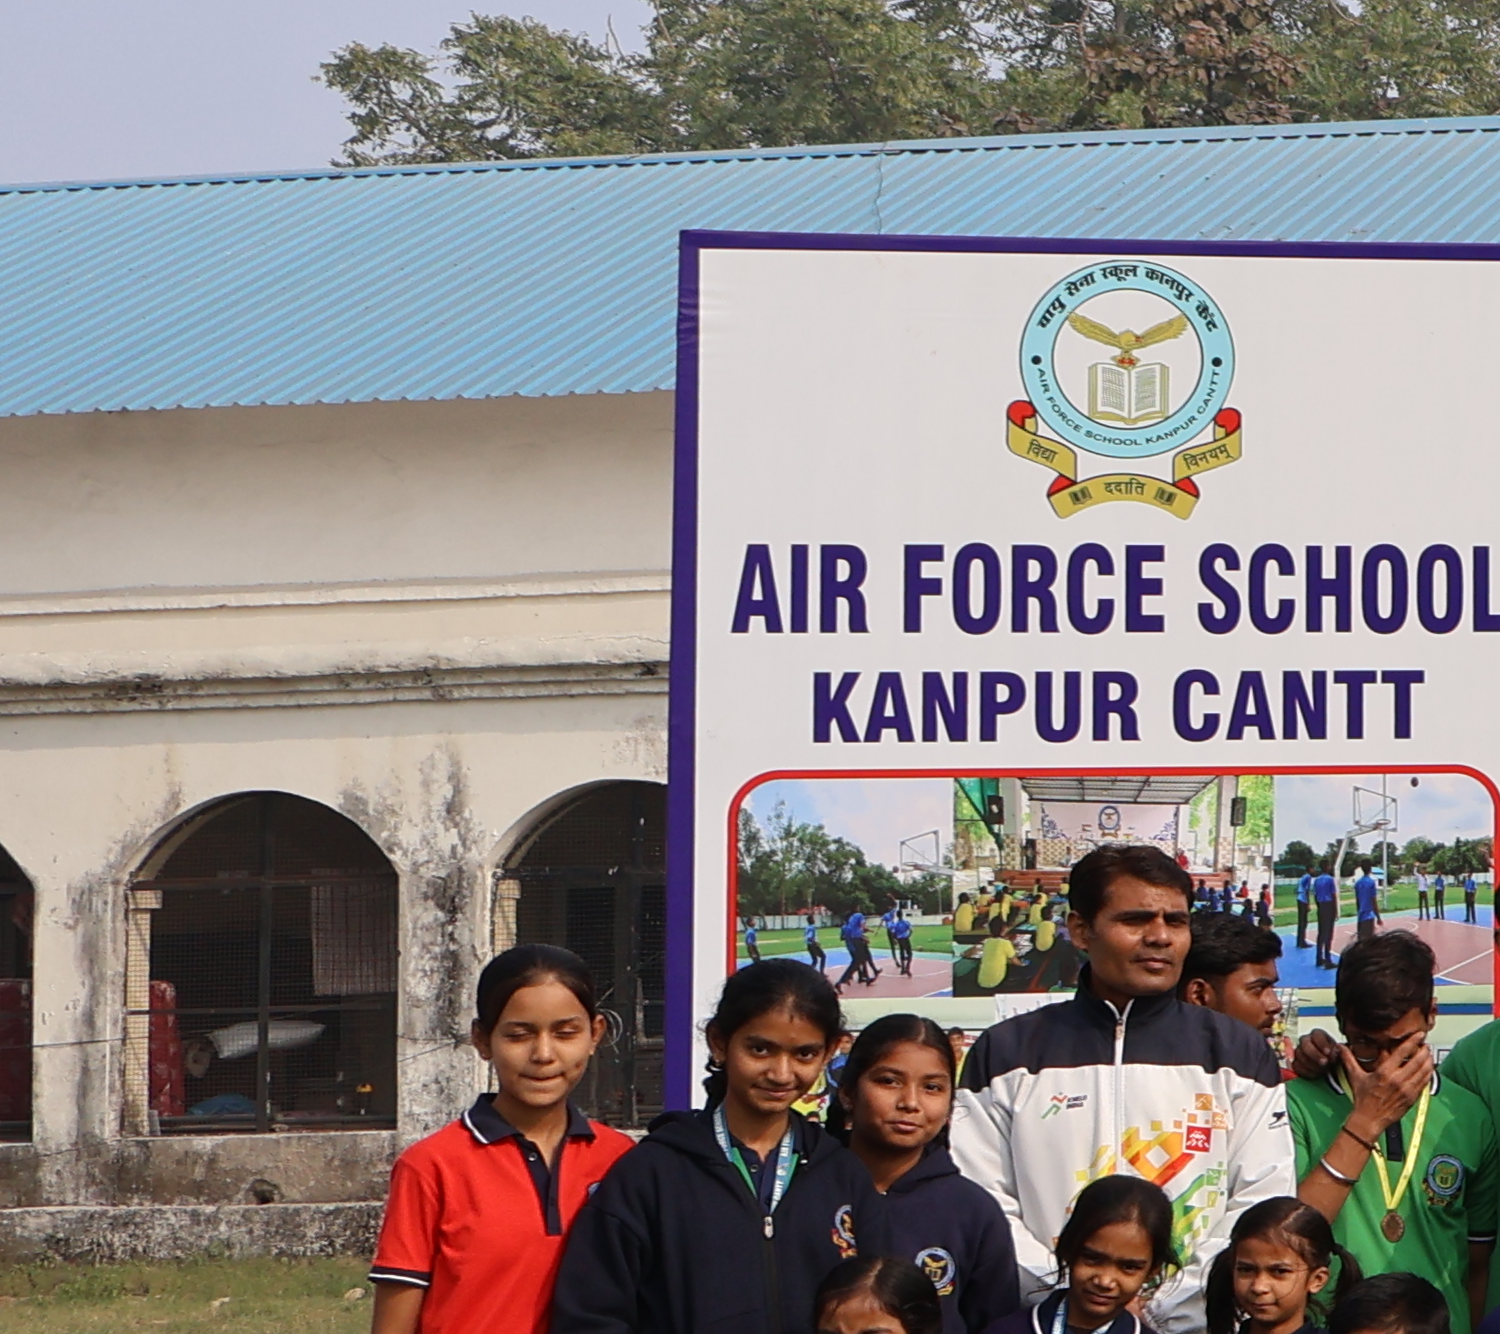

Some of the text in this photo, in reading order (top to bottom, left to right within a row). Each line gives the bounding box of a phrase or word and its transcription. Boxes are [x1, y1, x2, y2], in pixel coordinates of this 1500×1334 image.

[1100, 264, 1138, 282] स्कूल
[1145, 265, 1195, 302] कानपुर
[1037, 368, 1221, 446] AIR FORCE SCHOOL KANPUR CANTT
[1104, 479, 1146, 496] ददाति
[729, 542, 870, 635] AIR
[902, 542, 1166, 636] FORCE
[812, 669, 1426, 744] KANPUR CANTT
